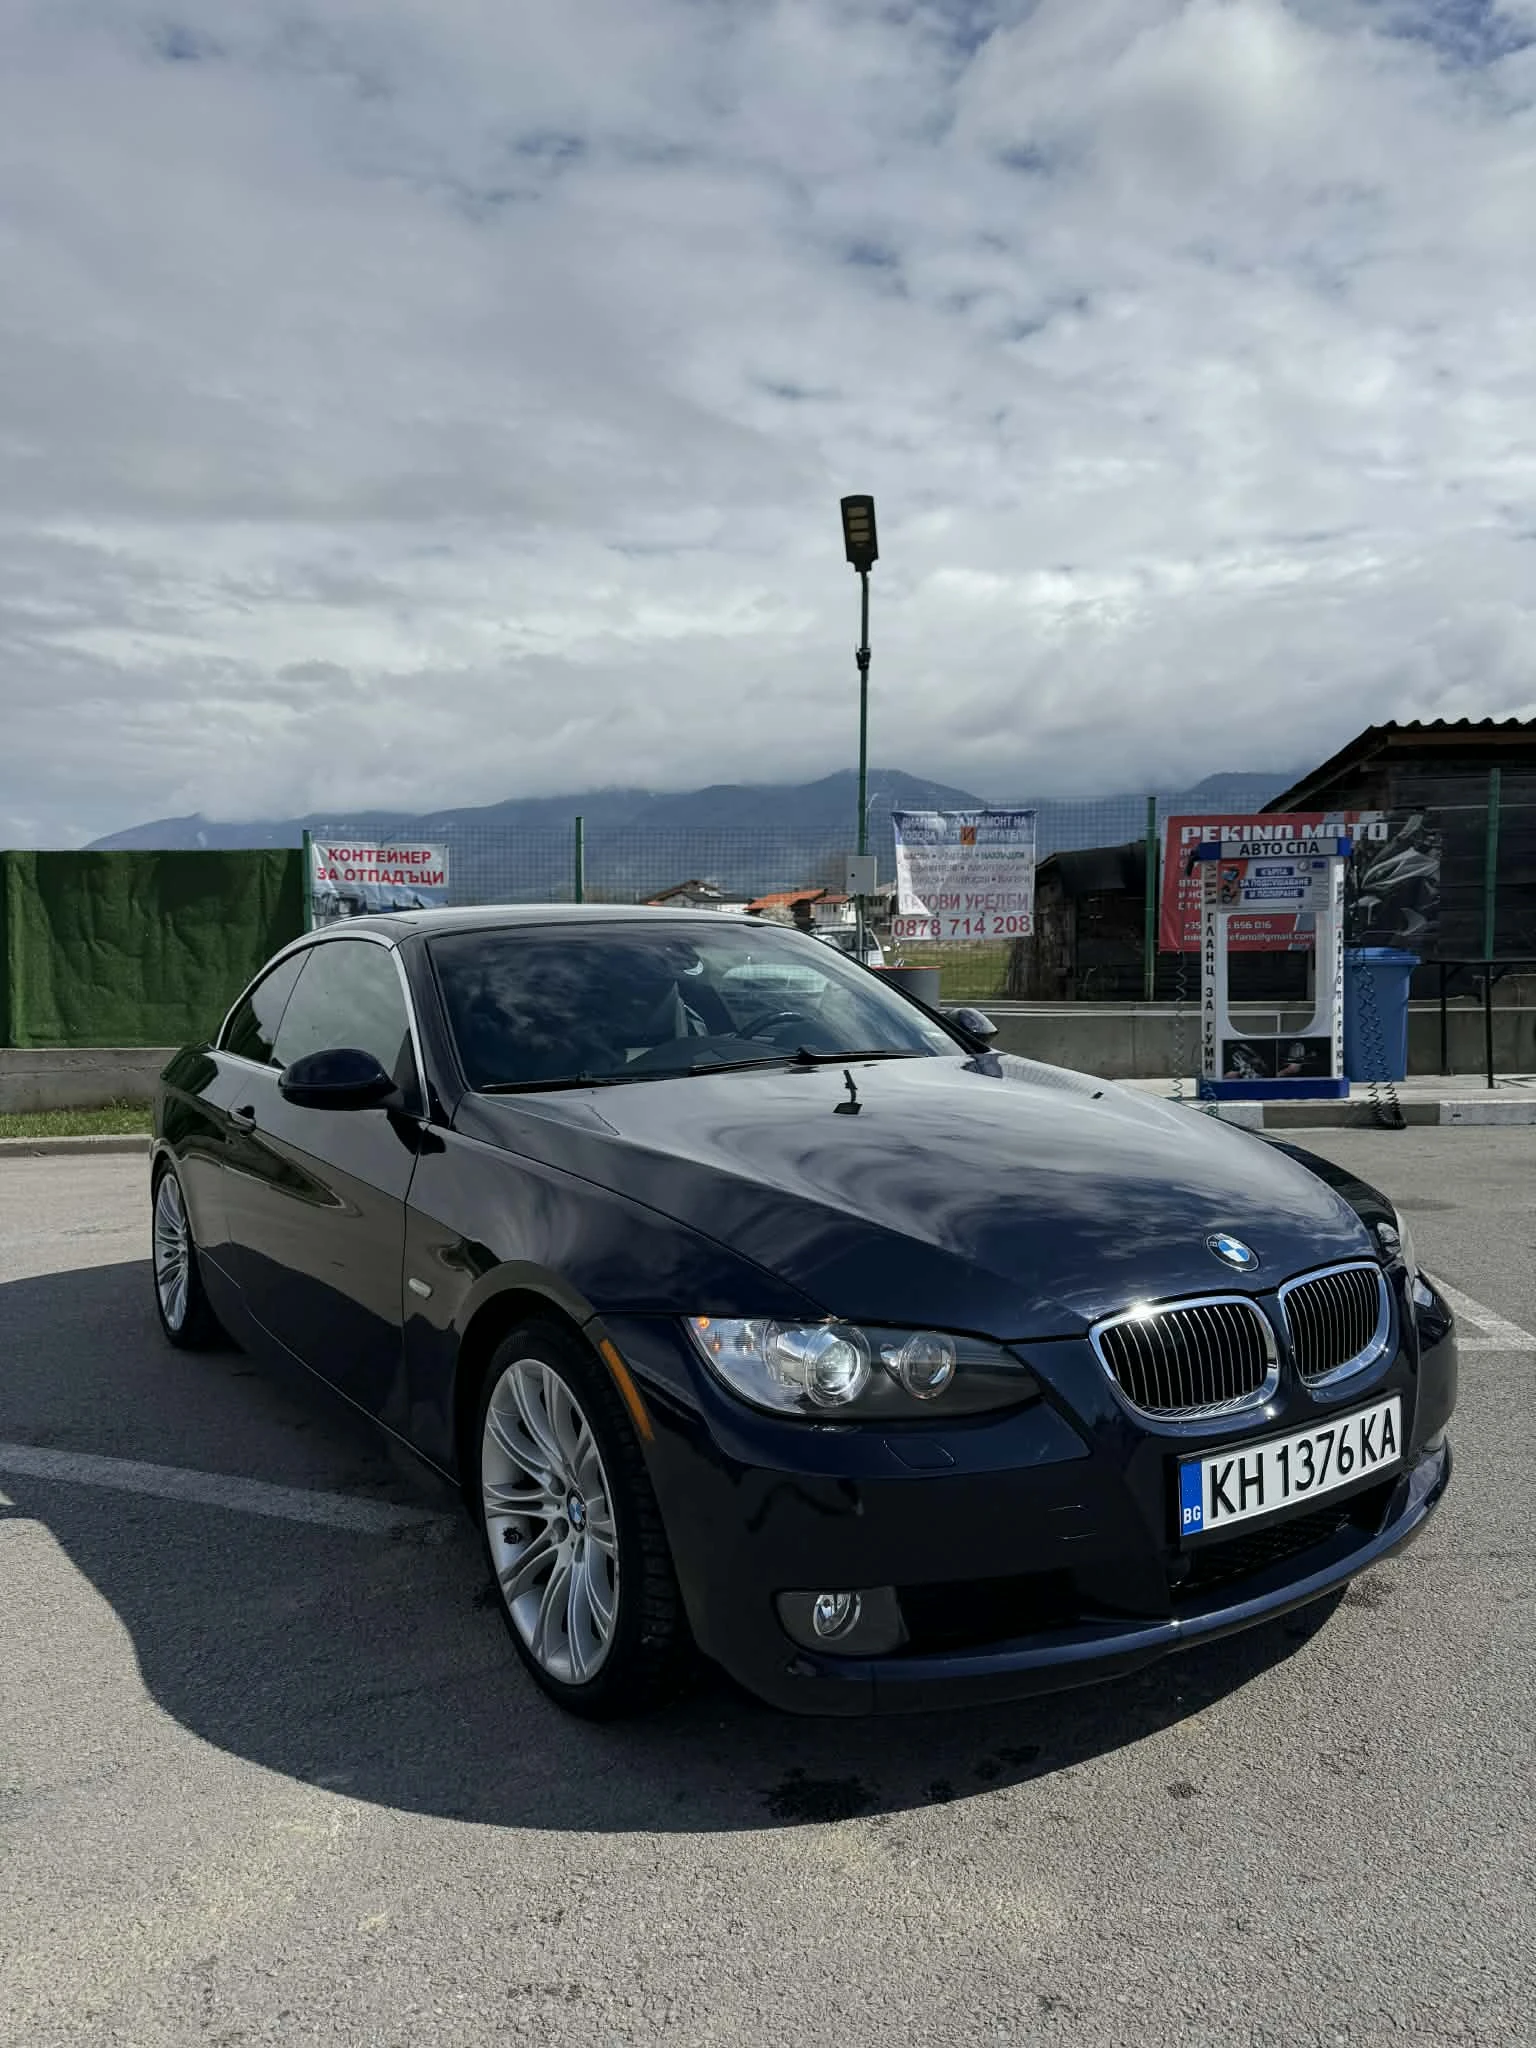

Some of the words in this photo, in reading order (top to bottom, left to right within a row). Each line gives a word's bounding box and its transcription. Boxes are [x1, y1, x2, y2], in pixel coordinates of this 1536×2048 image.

[1014, 815, 1026, 827] НА
[328, 847, 431, 865] КОНТЕЙНЕР
[1239, 841, 1282, 856] АВТО
[1286, 840, 1320, 855] СПА
[317, 867, 339, 881] ЗА
[344, 868, 444, 886] ОТПАДЪЦИ
[965, 892, 1029, 912] УРЕДБИ
[894, 918, 941, 937] 0878
[949, 917, 986, 936] 714
[992, 915, 1031, 934] 208
[1205, 986, 1214, 1011] ЗА
[1210, 1453, 1265, 1519] KH
[1276, 1424, 1356, 1498] 1376
[1359, 1407, 1397, 1469] KA
[1183, 1505, 1202, 1525] BG
